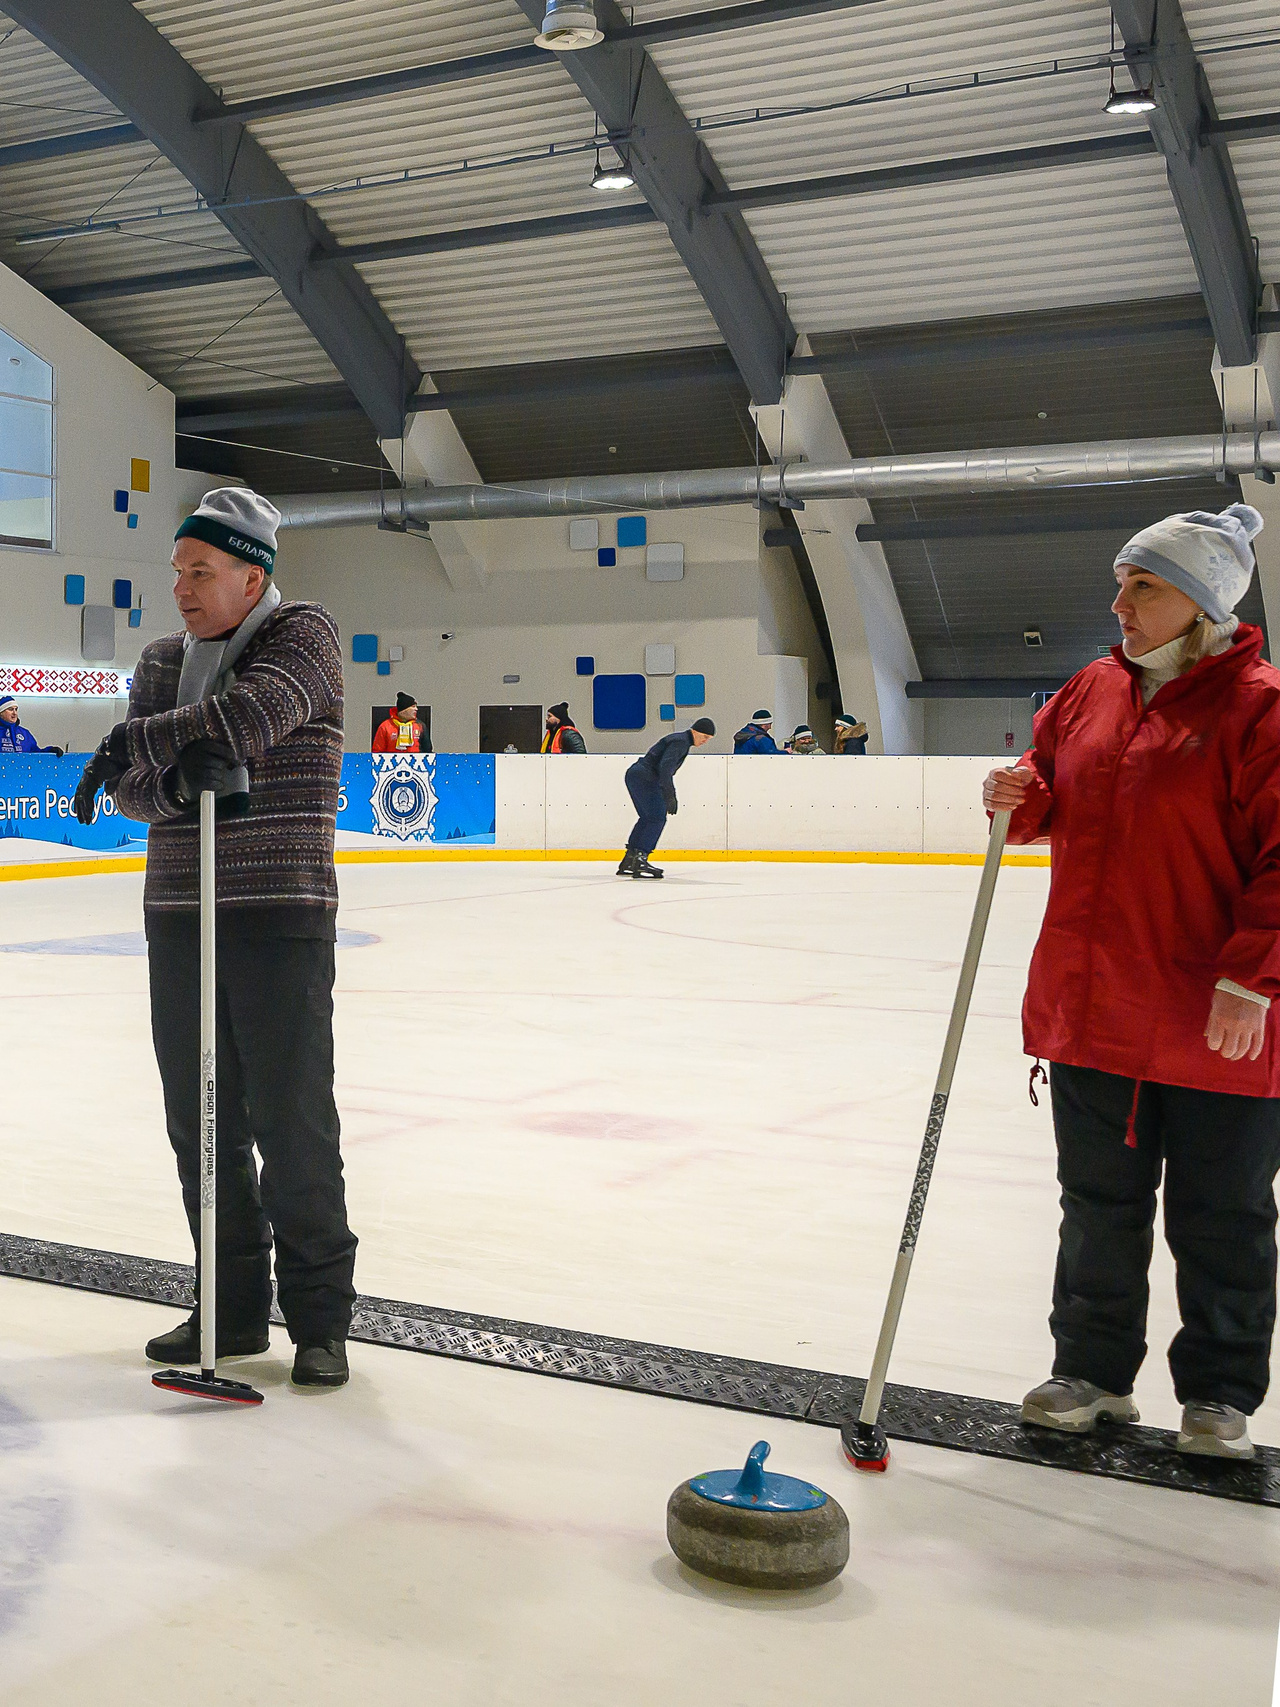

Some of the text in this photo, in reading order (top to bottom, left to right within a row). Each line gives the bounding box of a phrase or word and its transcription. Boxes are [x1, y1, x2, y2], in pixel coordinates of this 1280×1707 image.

[45, 788, 119, 825] Ресуб
[336, 785, 348, 812] 6
[205, 1119, 215, 1176] Fiberglass
